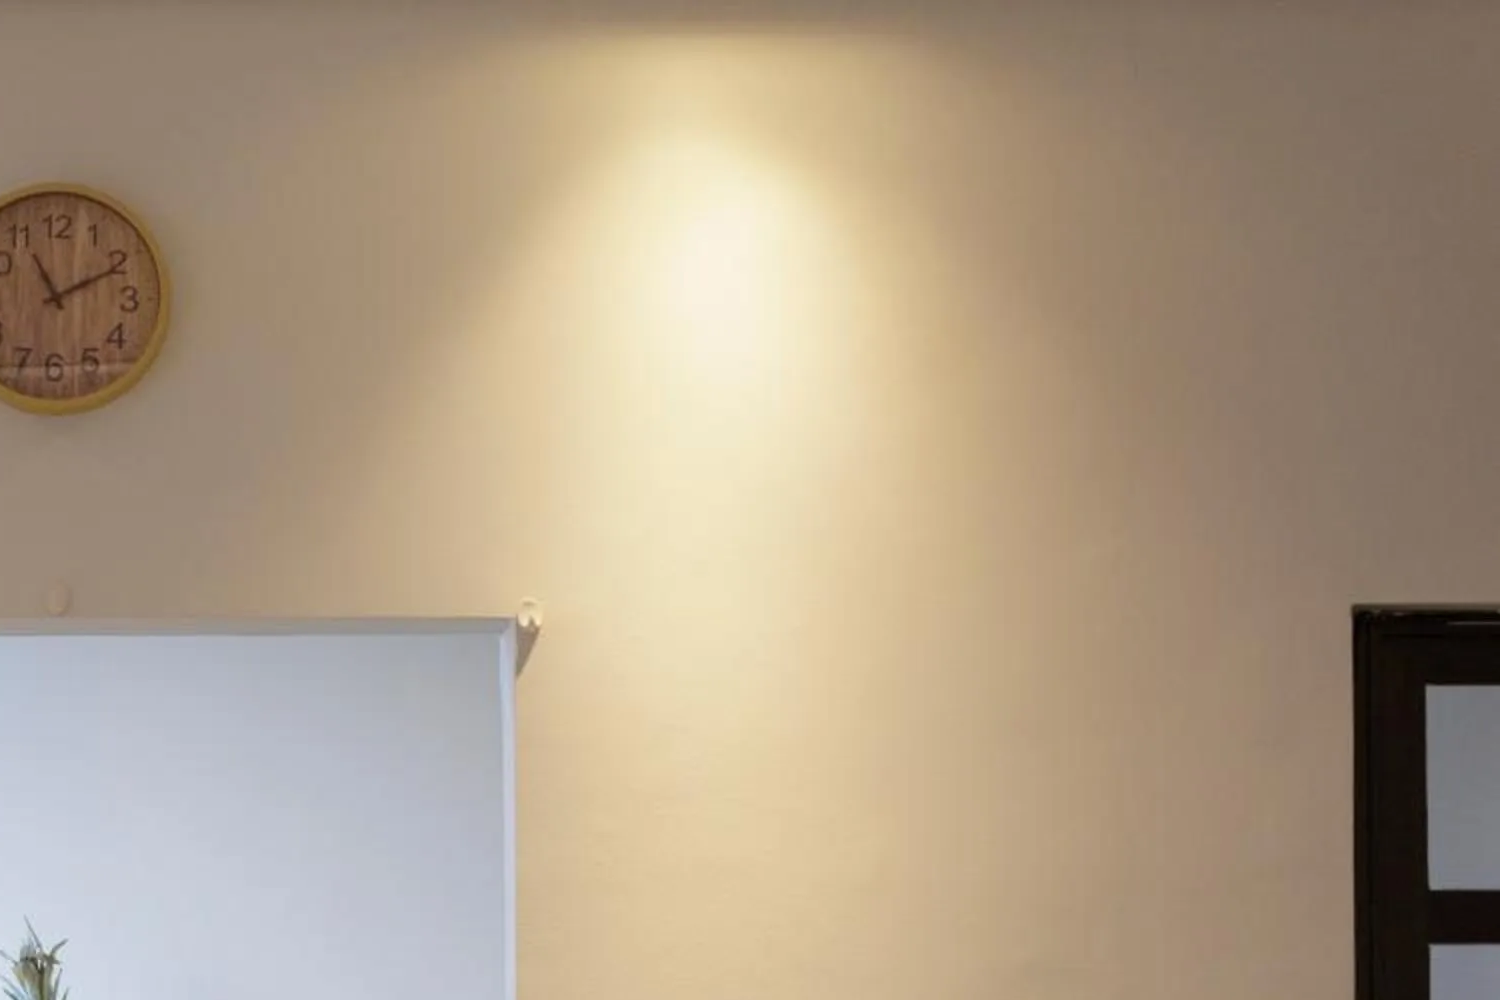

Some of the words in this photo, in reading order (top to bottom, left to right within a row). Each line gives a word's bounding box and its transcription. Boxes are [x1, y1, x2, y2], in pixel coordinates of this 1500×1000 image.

[9, 224, 30, 248] 11
[43, 214, 72, 239] 12
[88, 224, 98, 247] 1
[108, 250, 127, 275] 2
[120, 286, 139, 312] 3
[106, 323, 127, 349] 4
[14, 347, 33, 371] 7
[45, 354, 64, 382] 6
[82, 348, 100, 373] 5
